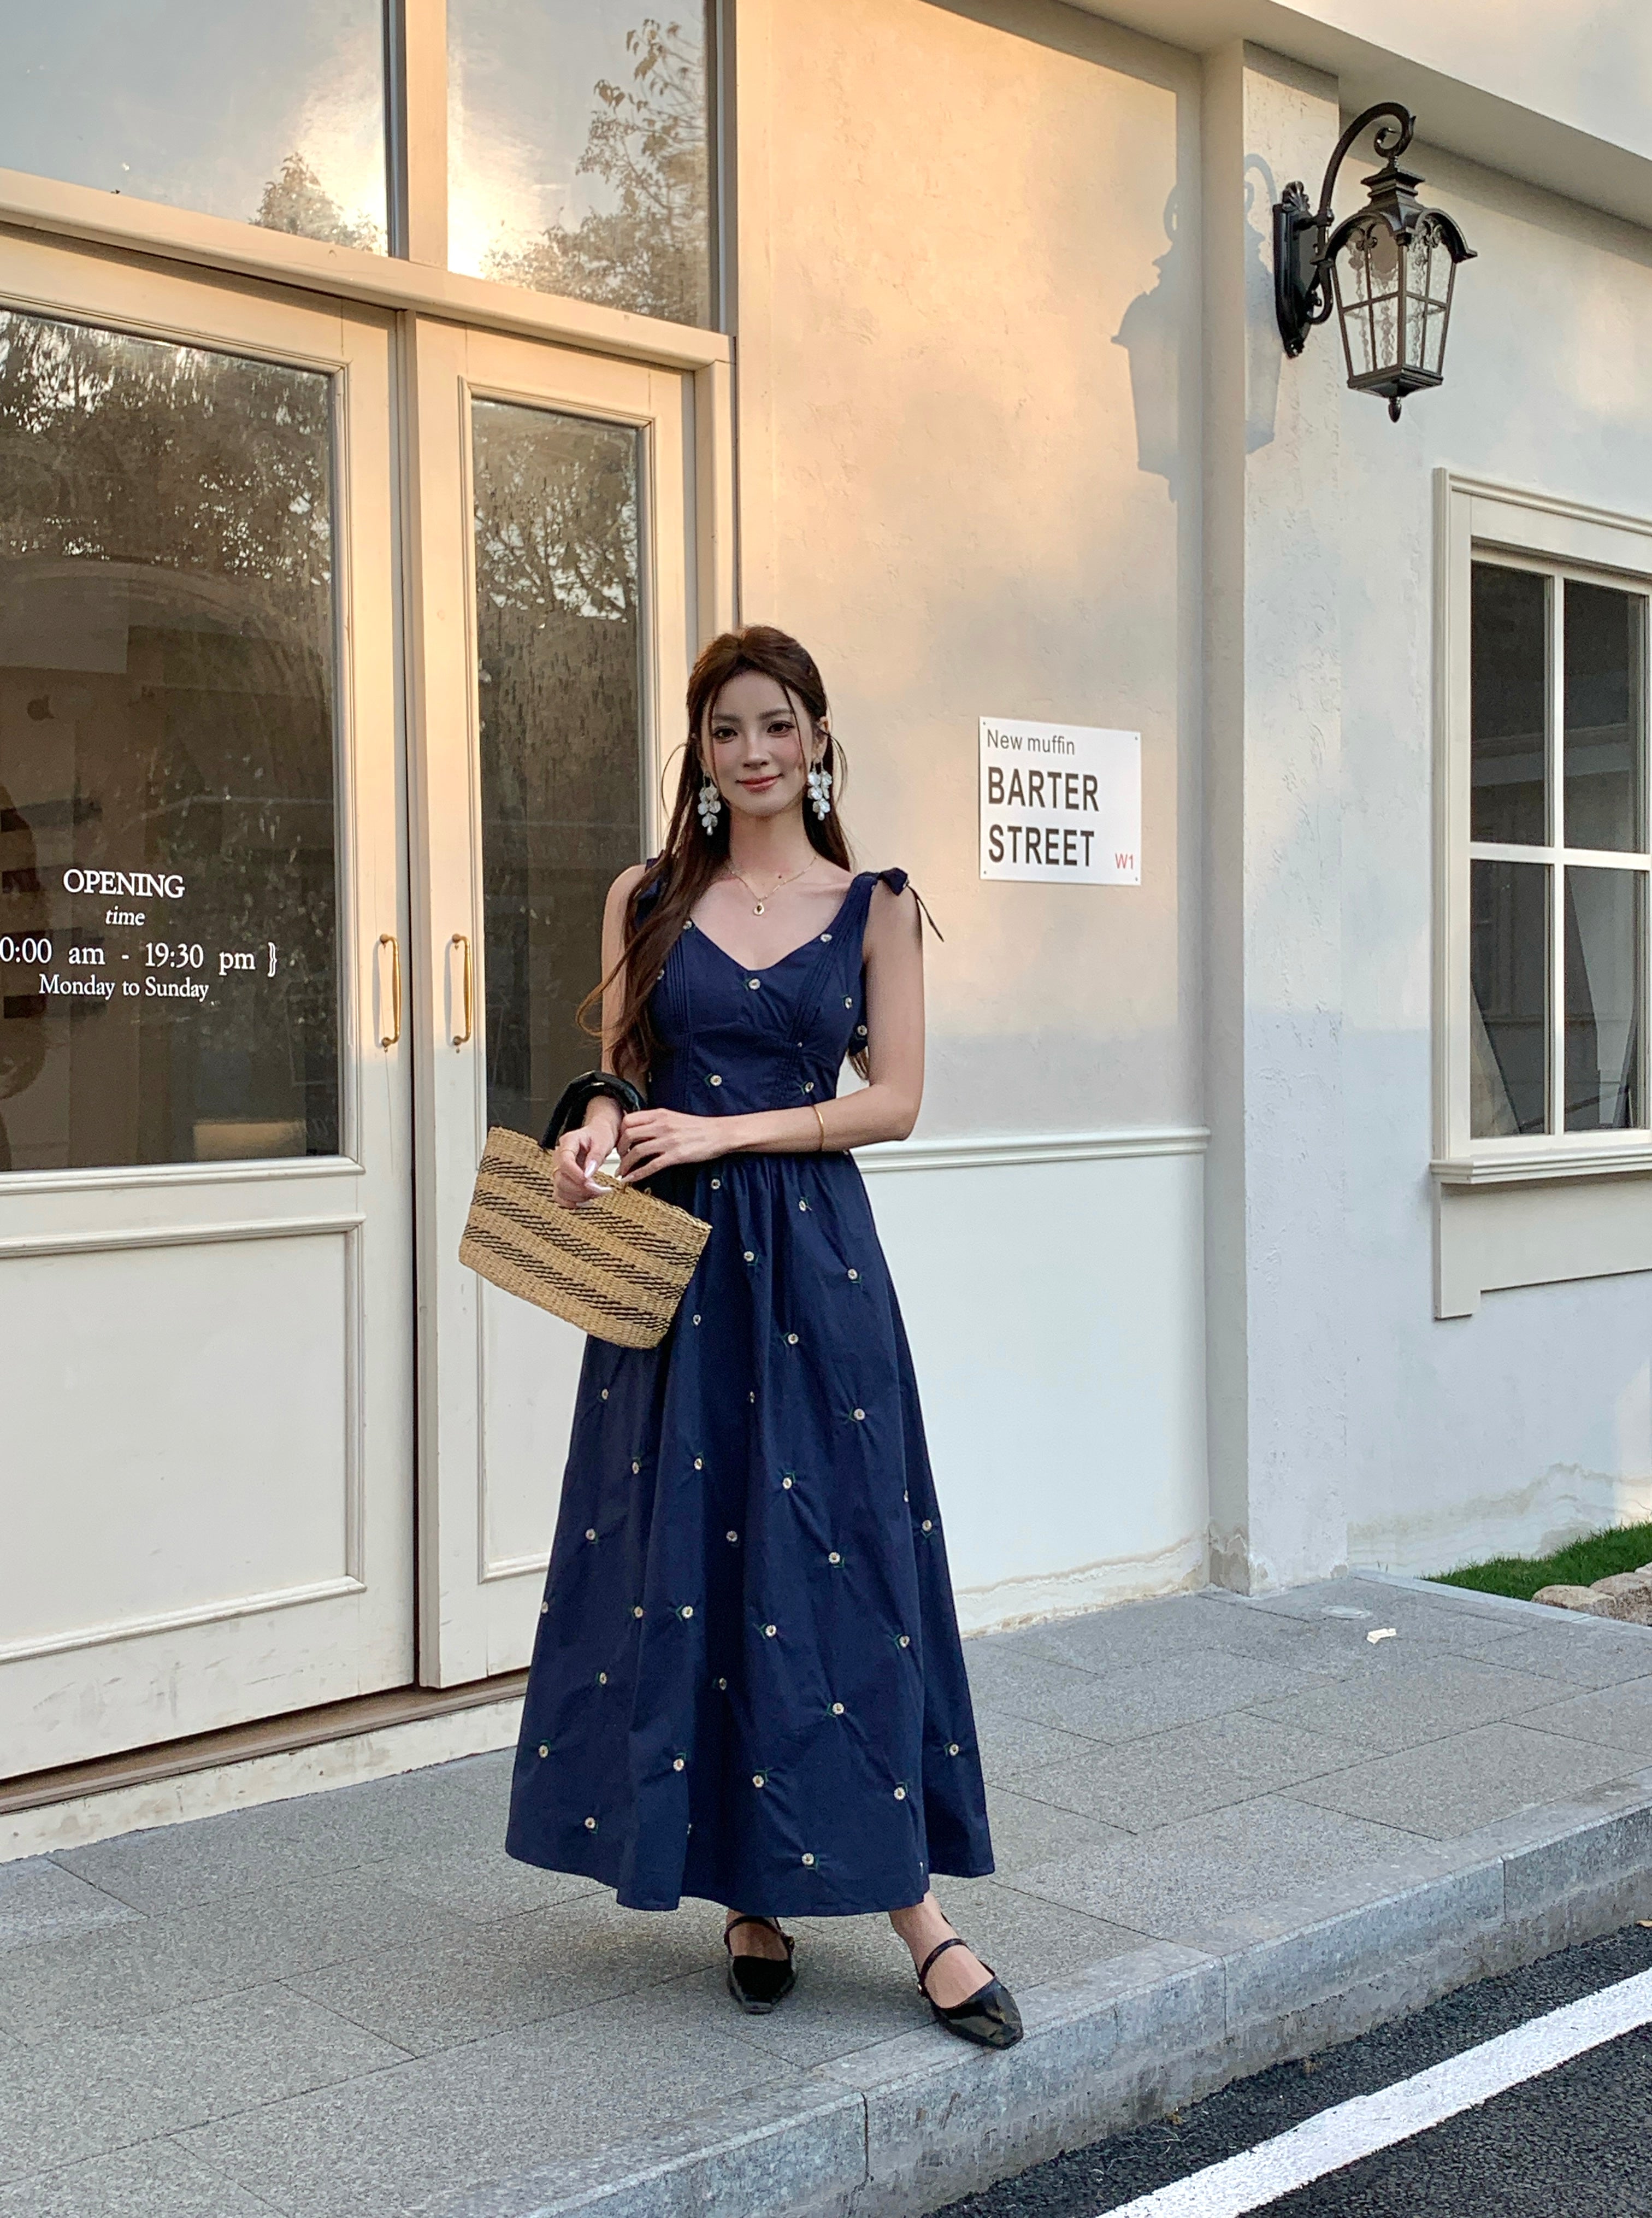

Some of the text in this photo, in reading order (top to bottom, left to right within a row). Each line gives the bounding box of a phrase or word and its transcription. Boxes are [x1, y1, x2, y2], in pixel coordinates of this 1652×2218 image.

[987, 728, 1075, 756] New muffin
[988, 766, 1100, 812] BARTER
[988, 823, 1095, 867] STREET
[1114, 853, 1135, 869] W1
[63, 869, 186, 899] OPENING
[105, 905, 146, 926] time
[68, 946, 106, 965] am
[145, 942, 204, 968] 19:30
[219, 951, 256, 976] pm
[38, 973, 210, 1003] Monday to Sunday
